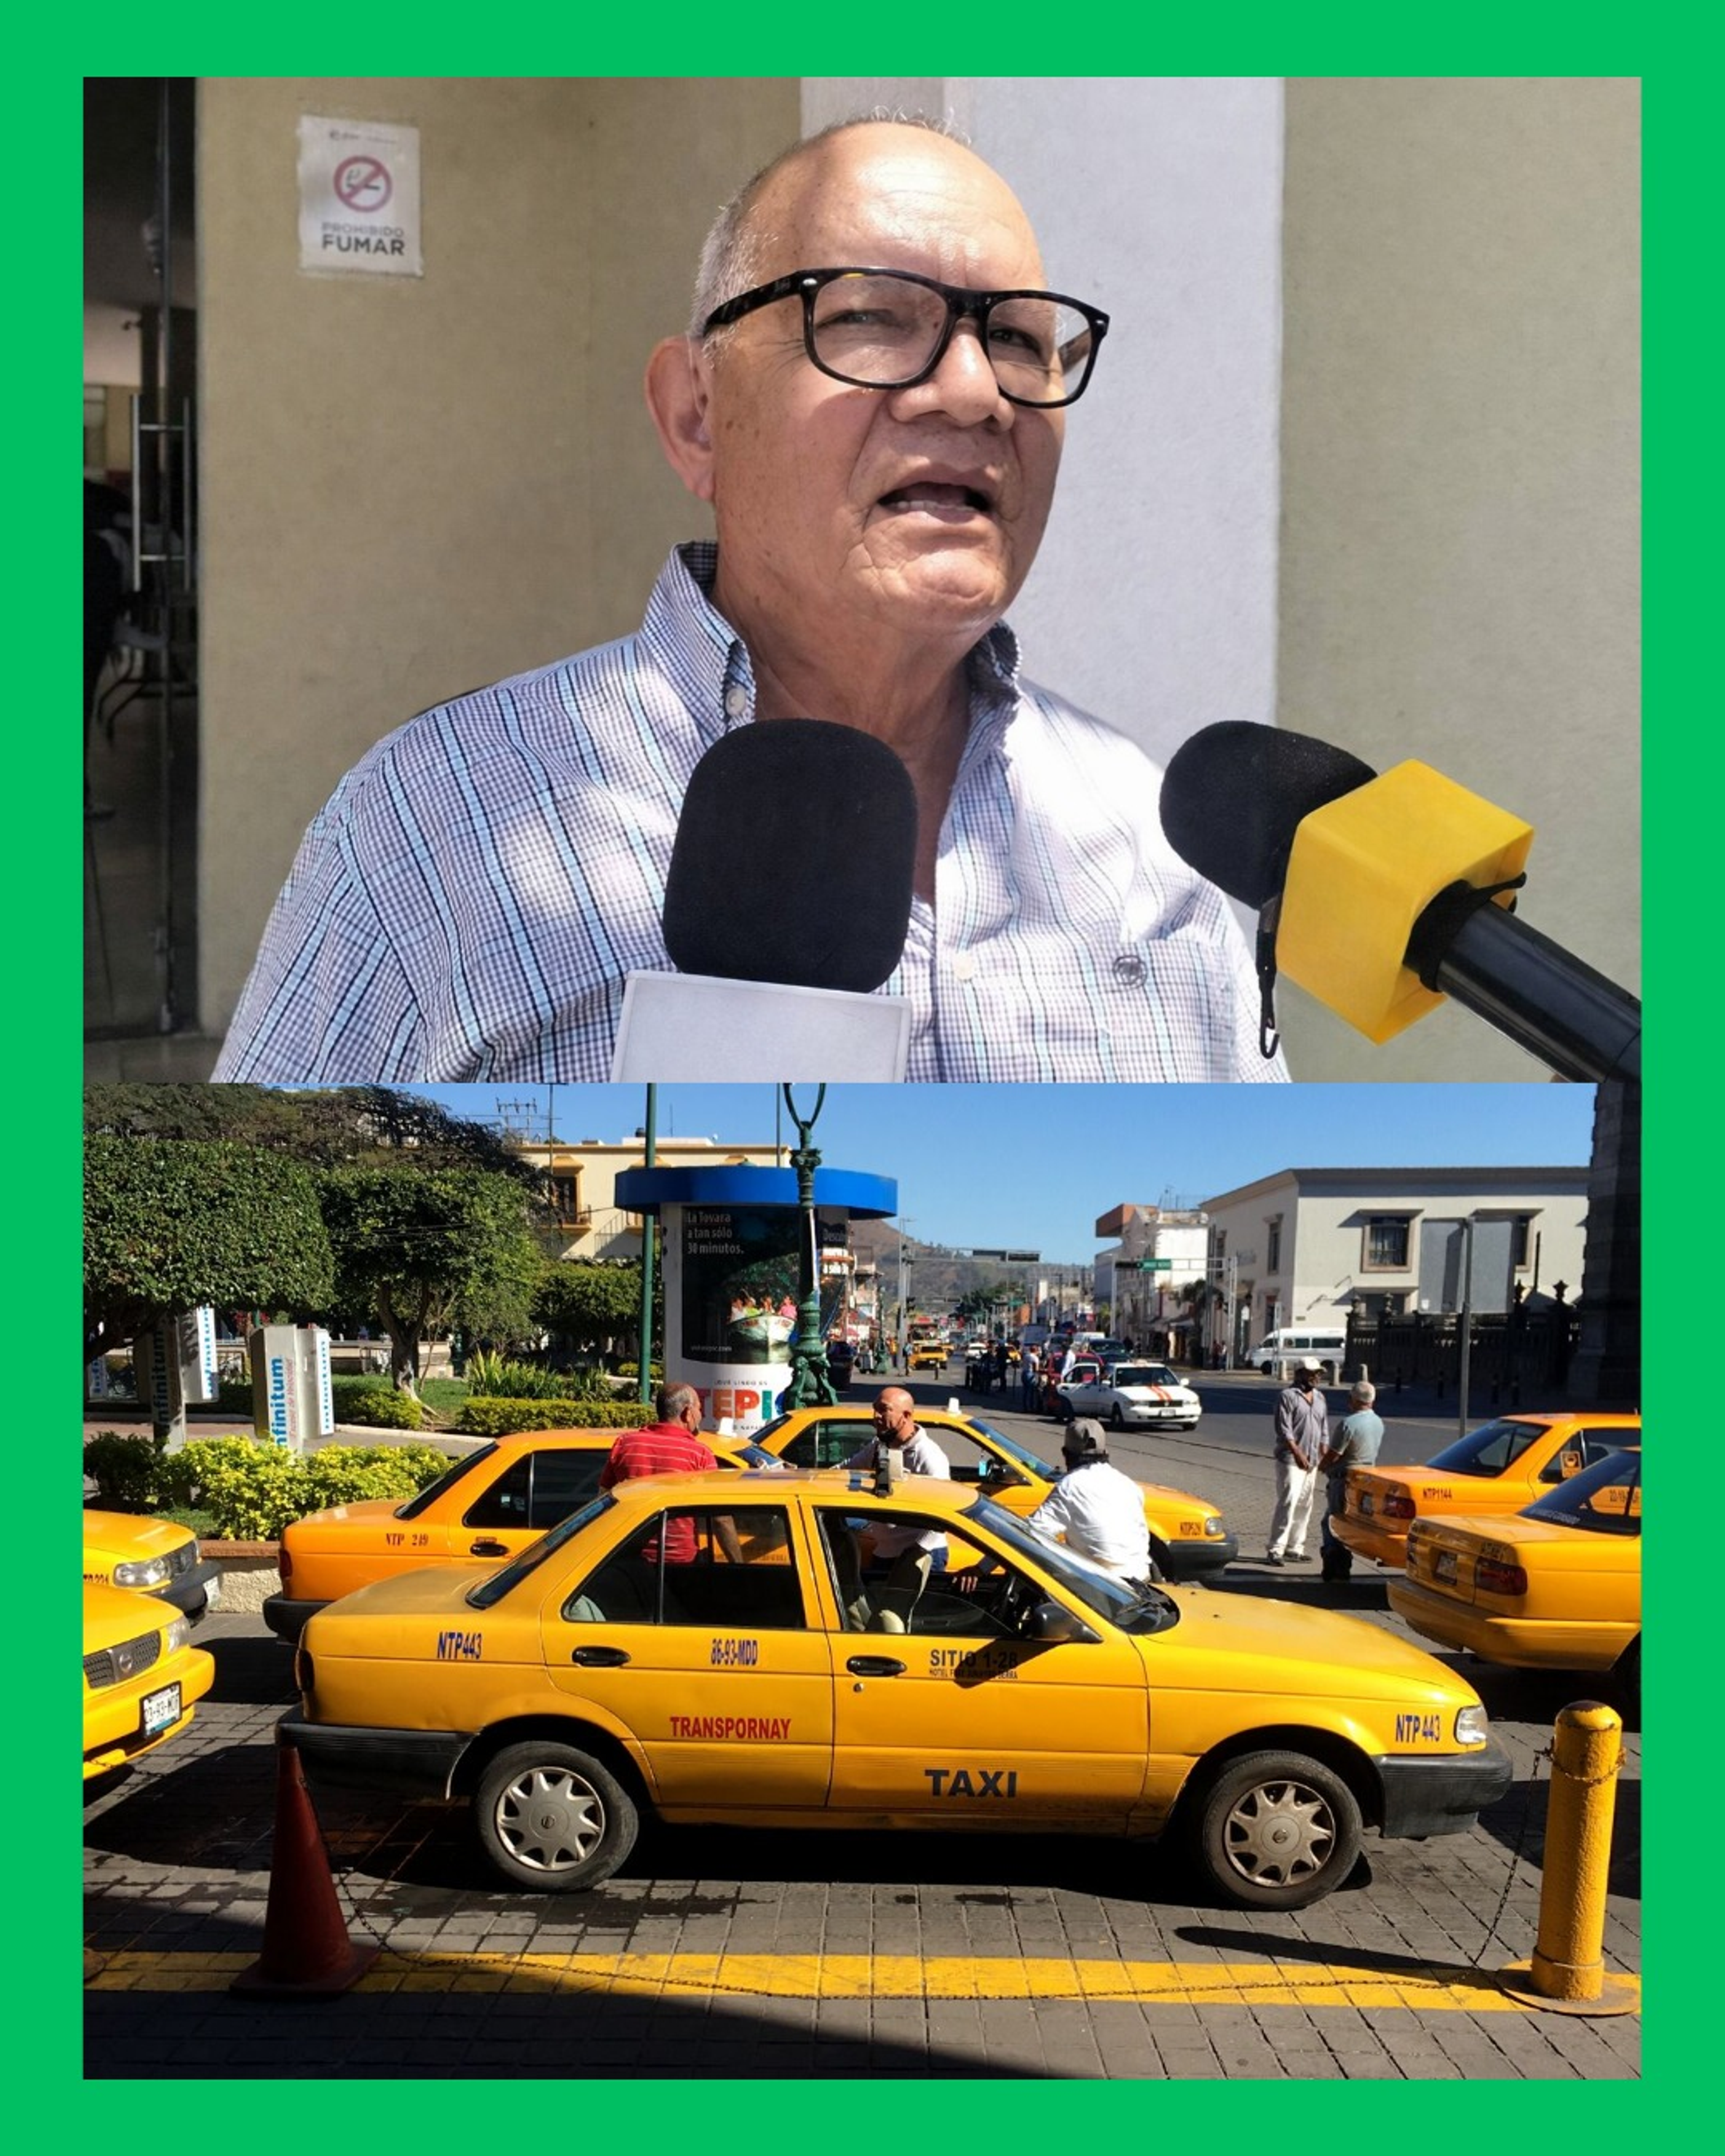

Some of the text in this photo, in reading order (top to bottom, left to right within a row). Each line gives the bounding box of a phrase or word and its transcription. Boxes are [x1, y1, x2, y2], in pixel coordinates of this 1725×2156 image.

[322, 222, 404, 238] PROHIBIDO
[322, 234, 405, 256] FUMAR
[688, 1211, 731, 1223] La Tovara
[688, 1226, 733, 1239] a tan sólo
[688, 1241, 745, 1254] 30 minutos.
[270, 1358, 287, 1447] nfinitum
[386, 1533, 404, 1546] NTP
[930, 1649, 1018, 1669] SITIO 1-28
[670, 1716, 792, 1740] TRANSPORNAY
[924, 1769, 1017, 1798] TAXI
